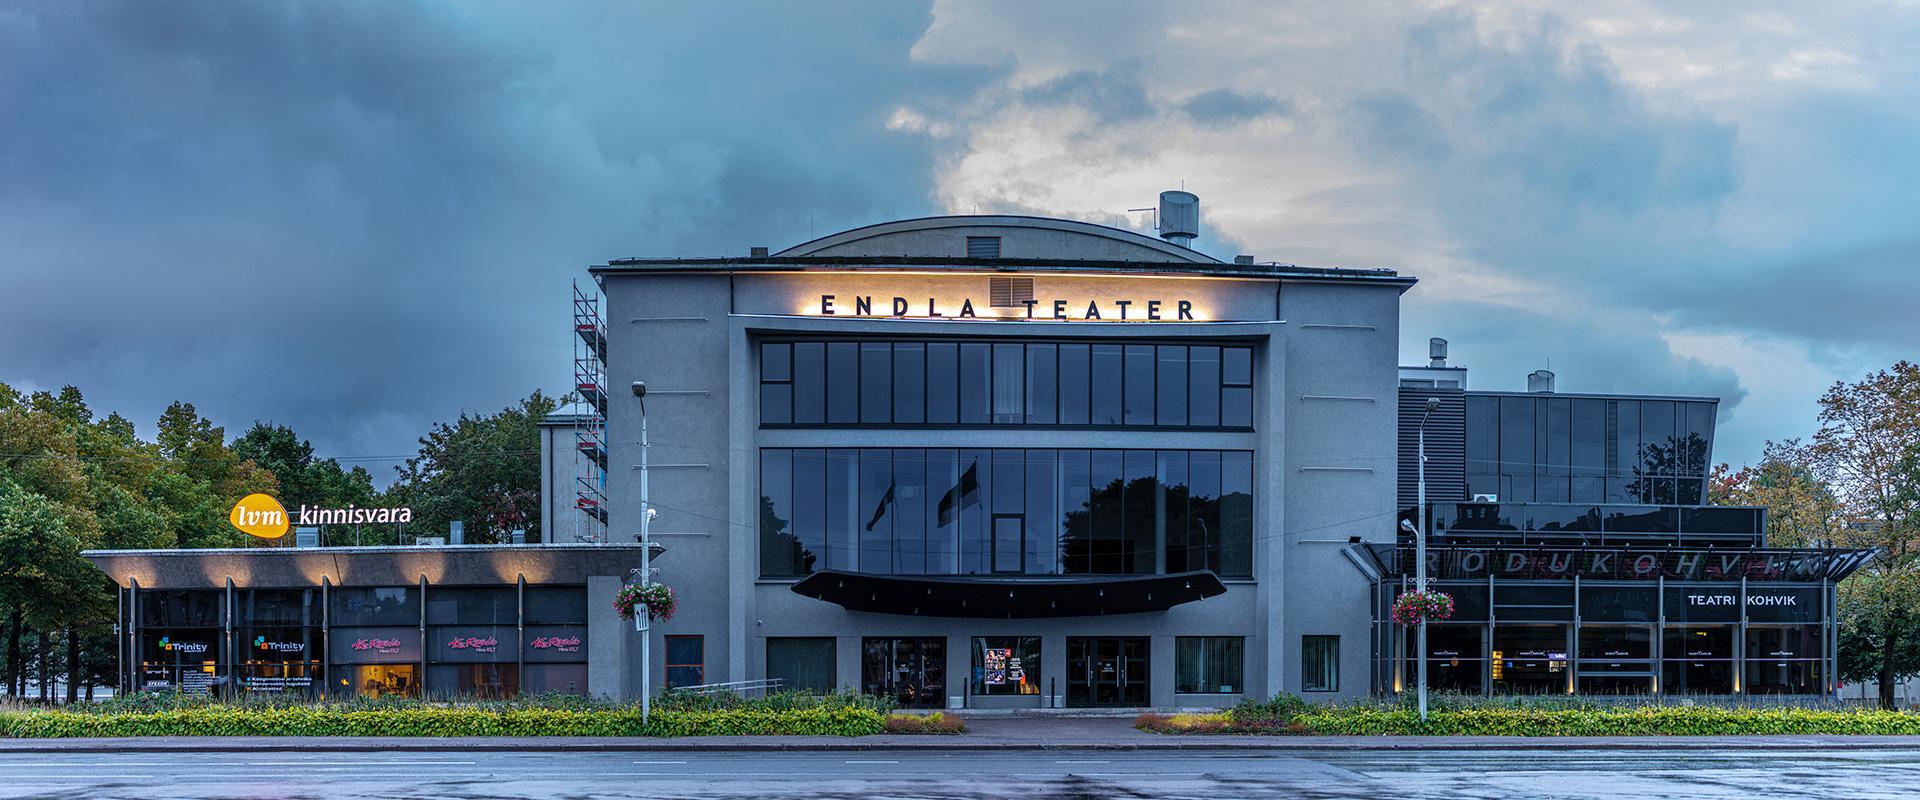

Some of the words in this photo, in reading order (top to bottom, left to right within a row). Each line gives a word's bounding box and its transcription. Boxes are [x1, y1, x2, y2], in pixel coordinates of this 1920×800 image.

[821, 294, 976, 318] ENDLA
[1021, 299, 1194, 320] TEATER
[237, 505, 283, 526] lvm
[300, 504, 412, 525] kinnisvara
[1688, 595, 1736, 606] TEATRI
[1747, 595, 1796, 606] KOHVIK
[172, 642, 208, 653] Trinity
[268, 641, 305, 652] Trinity
